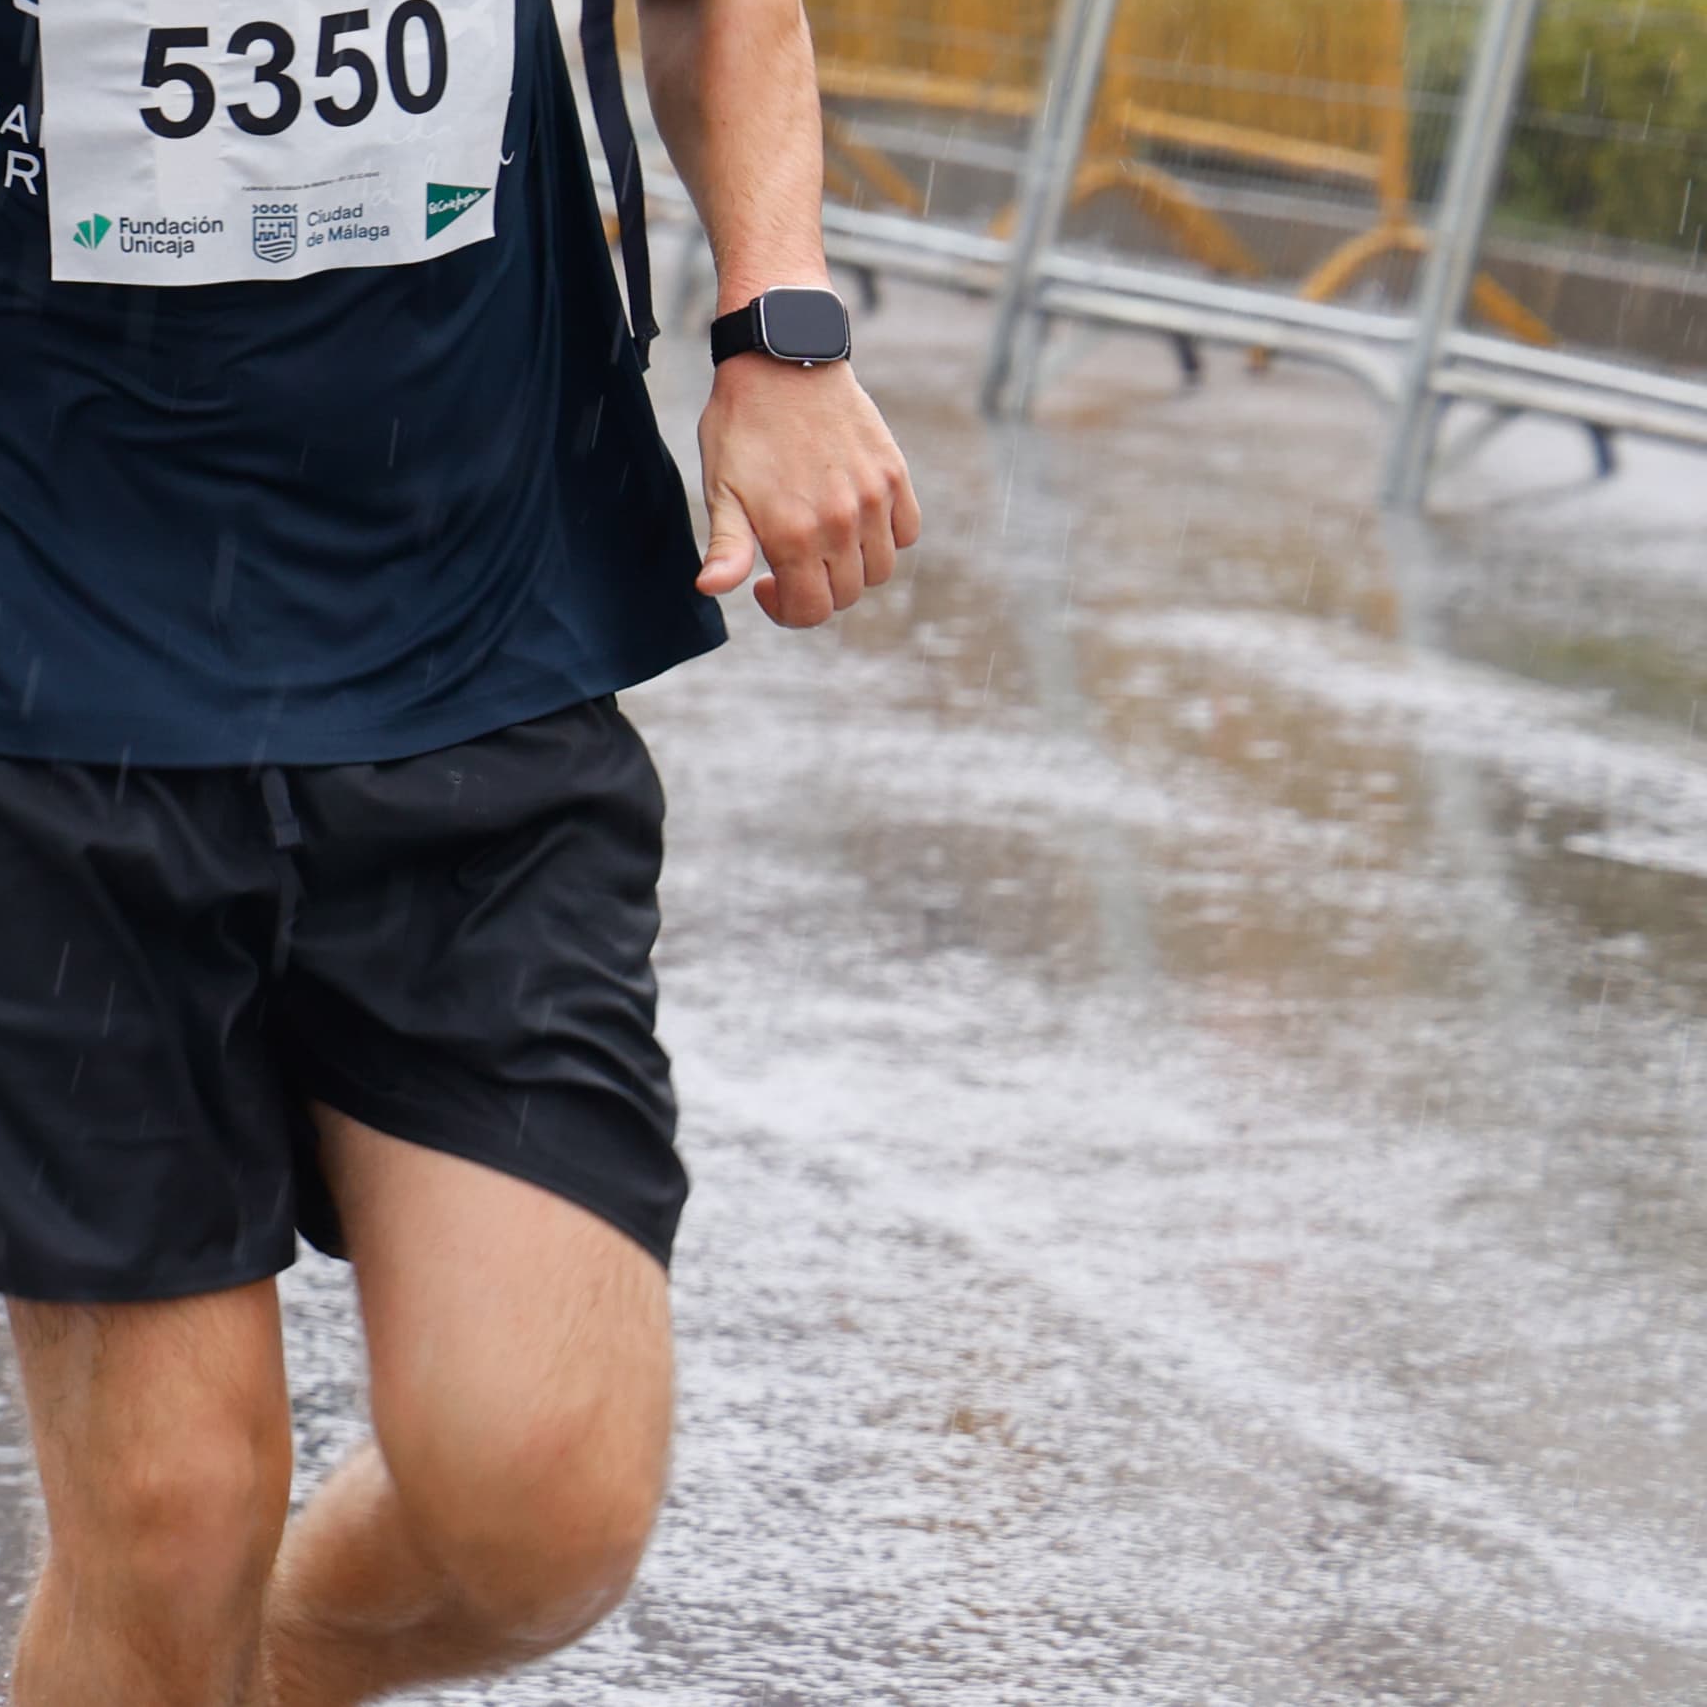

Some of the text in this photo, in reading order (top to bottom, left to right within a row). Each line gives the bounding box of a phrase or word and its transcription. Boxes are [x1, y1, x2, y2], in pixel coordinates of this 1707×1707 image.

[119, 216, 224, 235] Fundación
[307, 202, 364, 227] Ciudad
[120, 235, 195, 259] Unicaja
[306, 223, 390, 248] de Málaga
